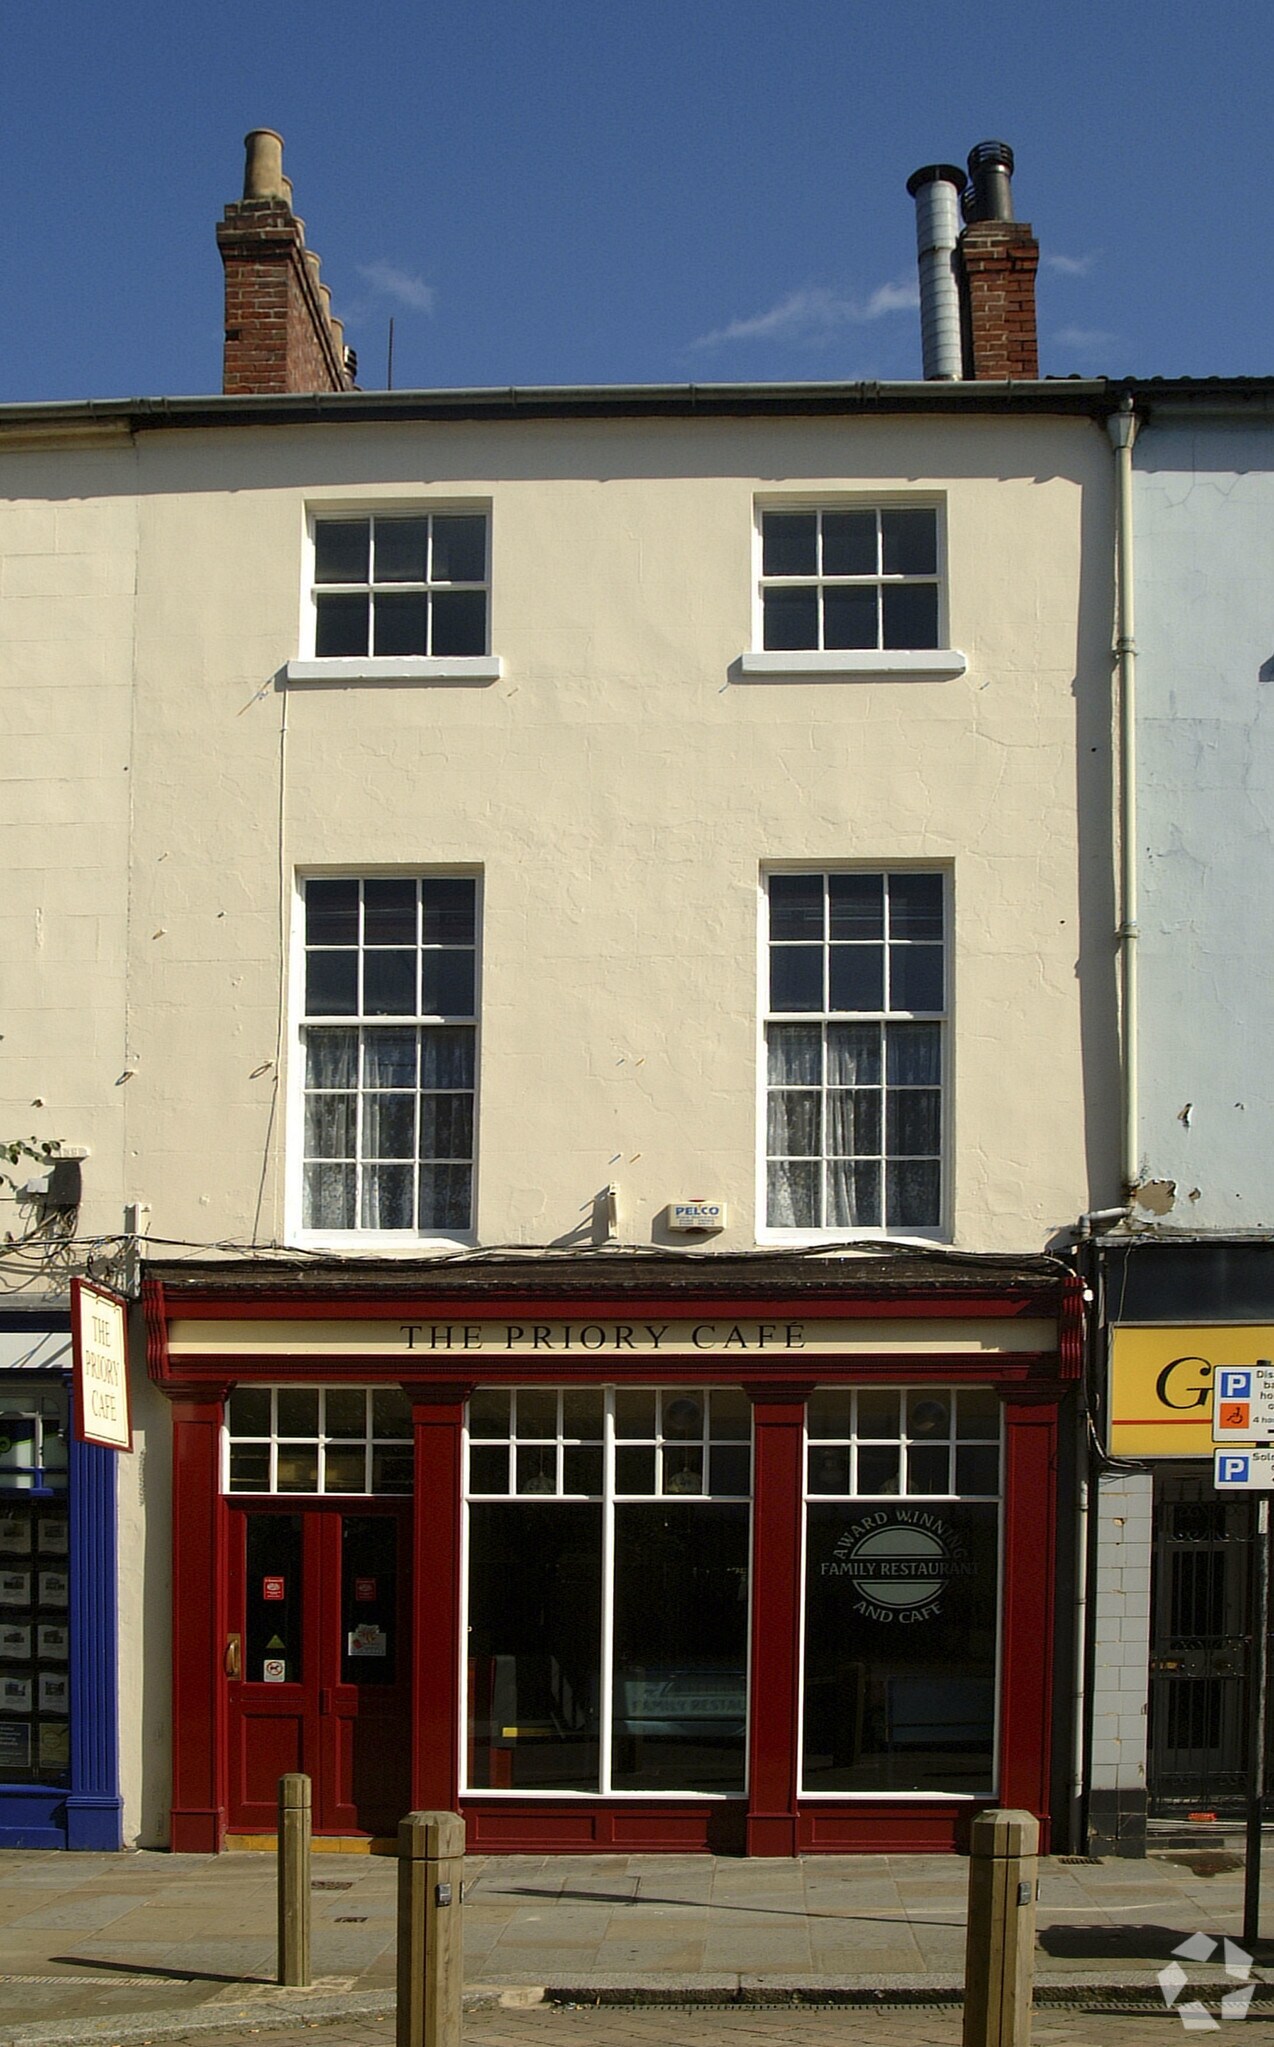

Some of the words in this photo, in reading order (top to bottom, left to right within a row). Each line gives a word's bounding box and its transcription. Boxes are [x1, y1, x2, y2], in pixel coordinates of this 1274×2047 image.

[675, 1206, 720, 1215] PELCO
[92, 1316, 111, 1347] THE
[400, 1325, 483, 1349] THE
[505, 1325, 669, 1349] PRIORY
[691, 1321, 805, 1349] CAFÉ
[86, 1350, 119, 1386] PRIORY
[1227, 1374, 1246, 1396] P
[1225, 1459, 1244, 1480] P
[832, 1511, 888, 1559] AWARD
[895, 1510, 967, 1559] WINNING
[820, 1562, 876, 1575] FAMILY
[879, 1562, 978, 1575] RESTAURANT
[853, 1600, 893, 1623] AND
[898, 1601, 944, 1623] CAFE
